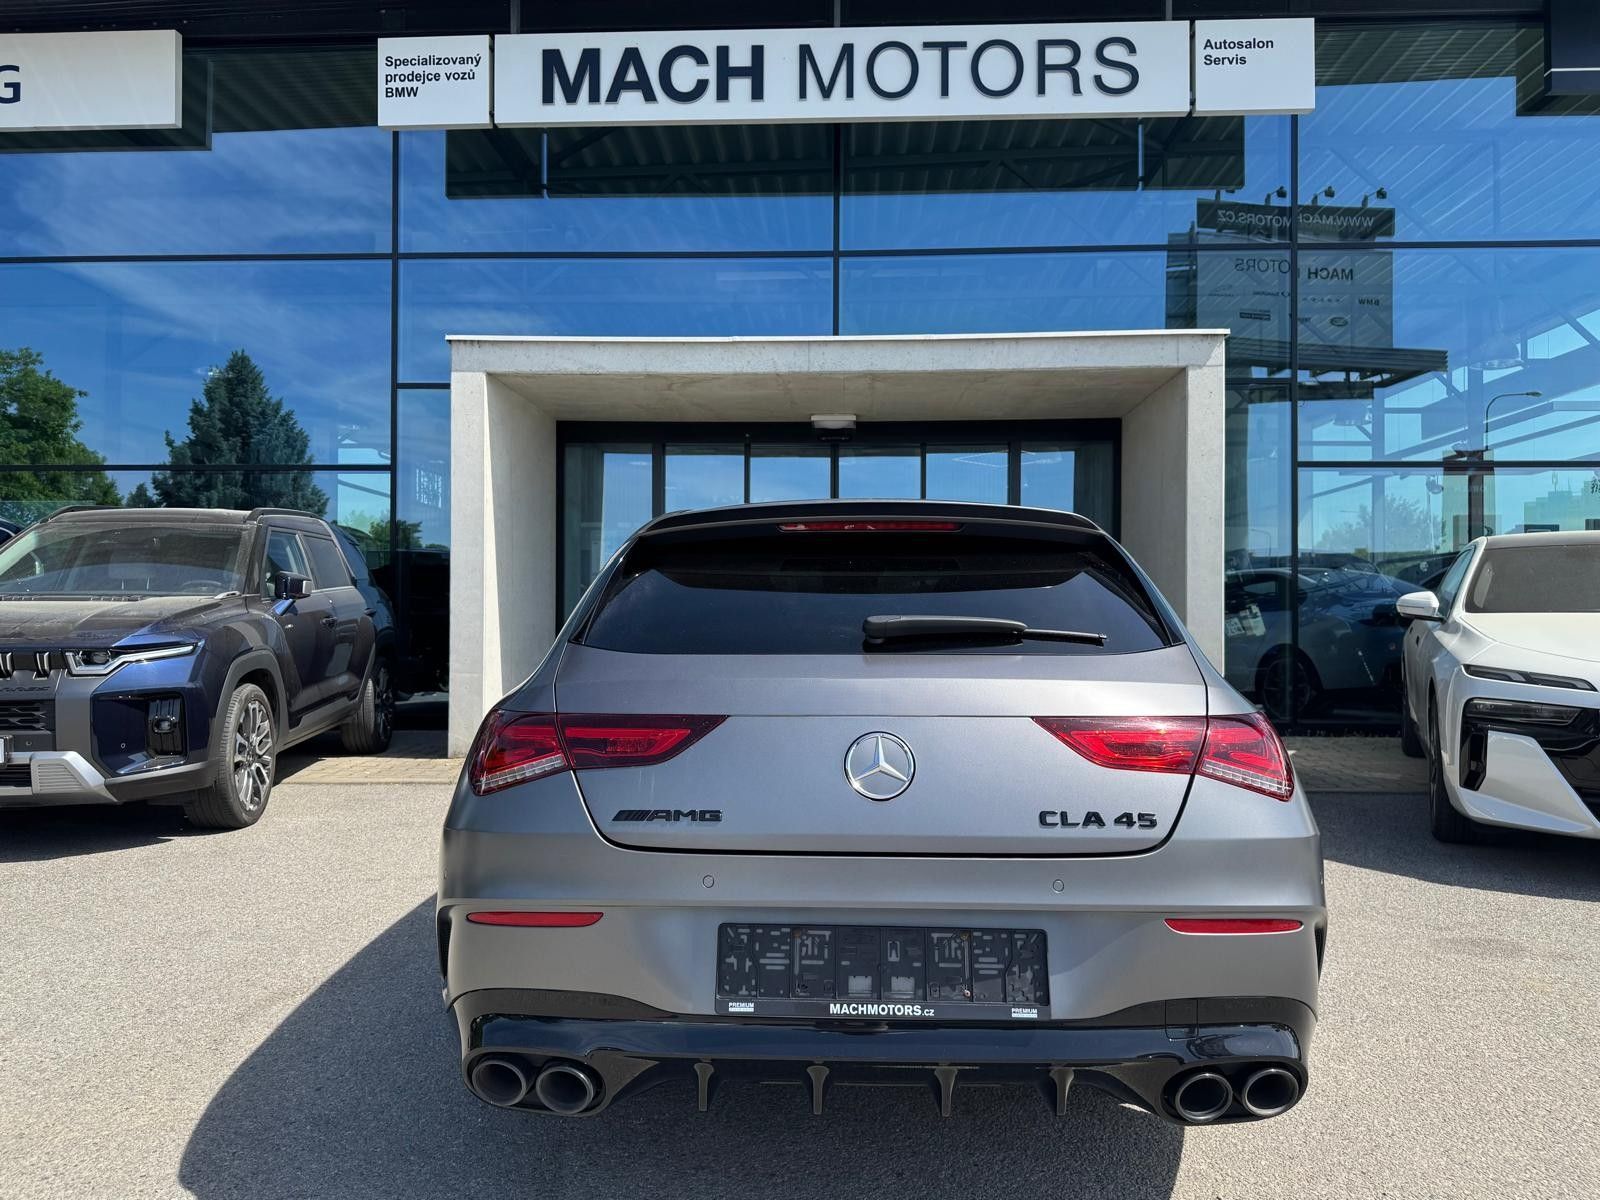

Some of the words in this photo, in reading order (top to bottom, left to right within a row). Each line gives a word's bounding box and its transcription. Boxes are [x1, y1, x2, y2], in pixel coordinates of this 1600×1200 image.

[1203, 37, 1275, 50] Autosalon
[385, 53, 482, 69] Specializovaný
[1203, 54, 1248, 66] Servis
[385, 70, 441, 85] prodejce
[445, 69, 476, 81] vozů
[541, 44, 765, 105] MACH
[798, 36, 1141, 101] MOTORS
[385, 86, 419, 98] BMW
[645, 809, 723, 822] AMG
[1038, 810, 1106, 828] CLA
[1113, 811, 1158, 829] 45
[829, 1003, 935, 1017] MACHMOTORS.cz
